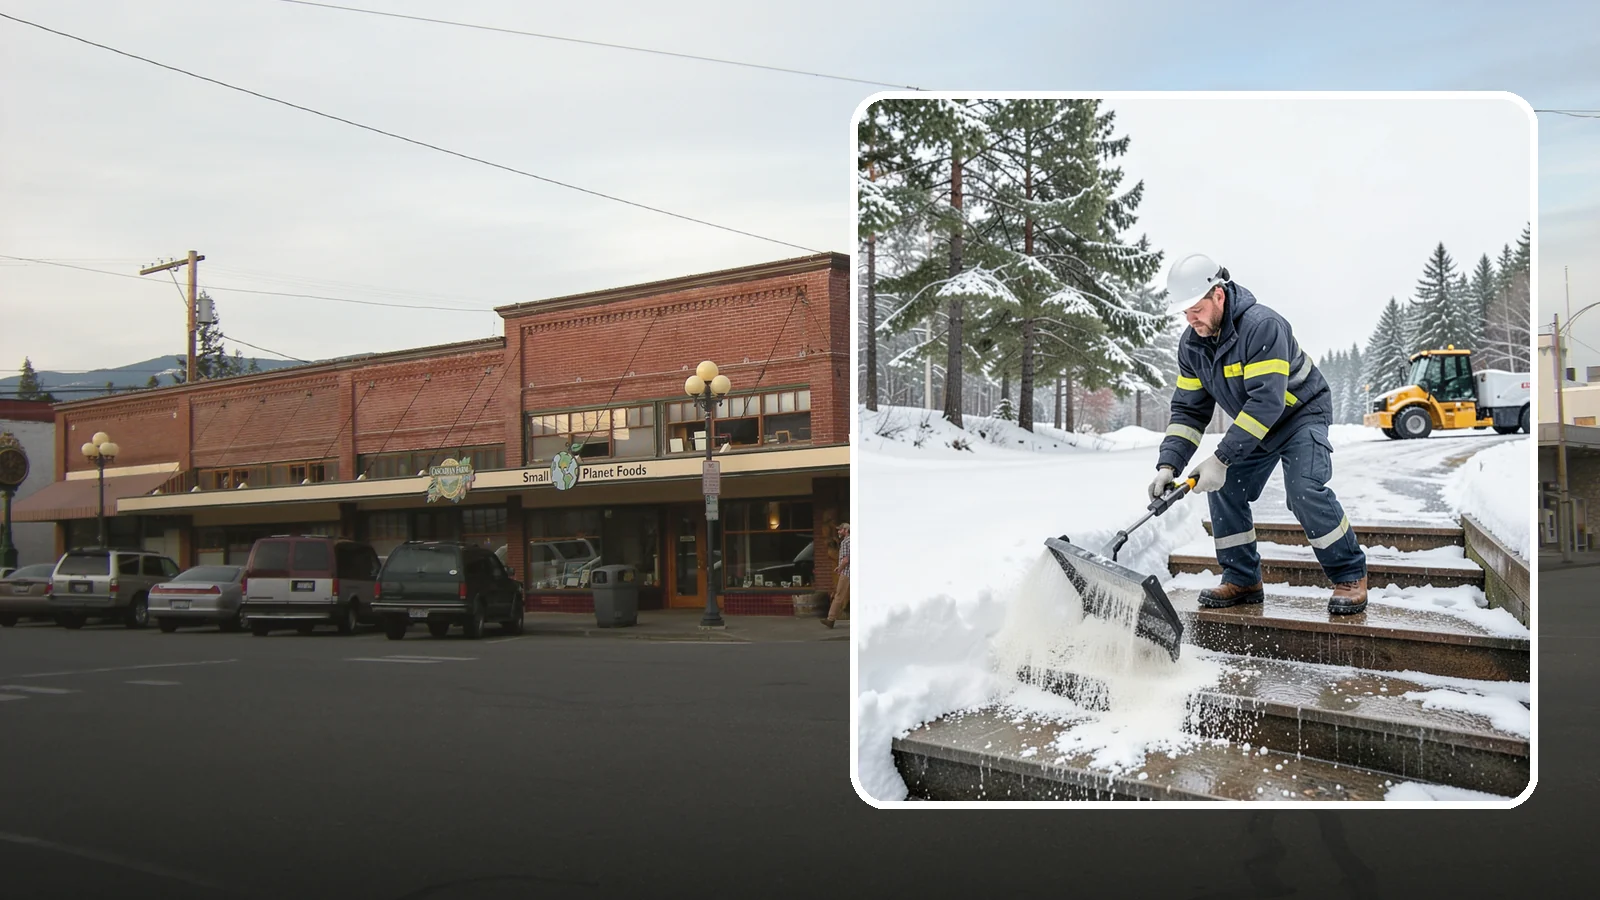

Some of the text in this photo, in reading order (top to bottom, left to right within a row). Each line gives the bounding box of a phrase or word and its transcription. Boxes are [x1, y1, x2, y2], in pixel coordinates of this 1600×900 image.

[523, 464, 647, 483] Small Planet Foods
